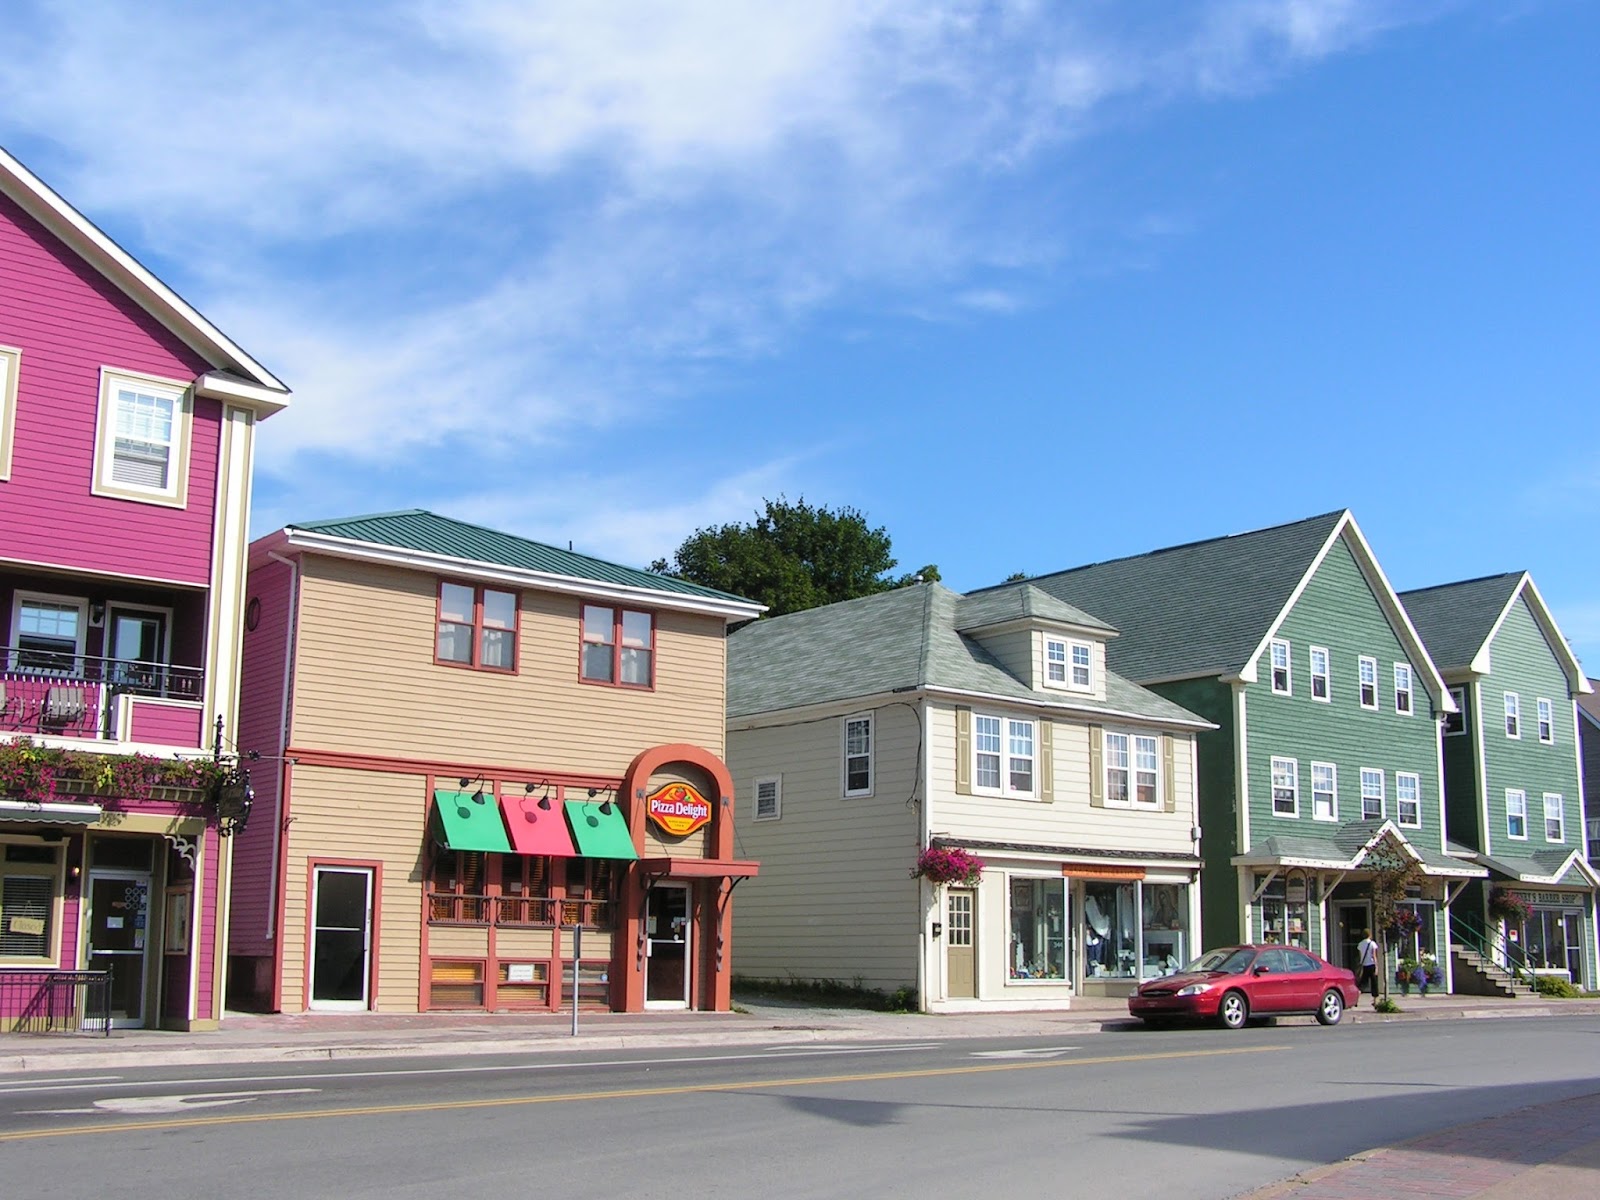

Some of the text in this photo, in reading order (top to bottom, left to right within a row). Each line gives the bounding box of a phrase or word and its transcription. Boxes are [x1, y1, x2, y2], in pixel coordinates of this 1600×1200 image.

[651, 800, 707, 819] Pizza Delight
[1538, 892, 1561, 903] BARBER
